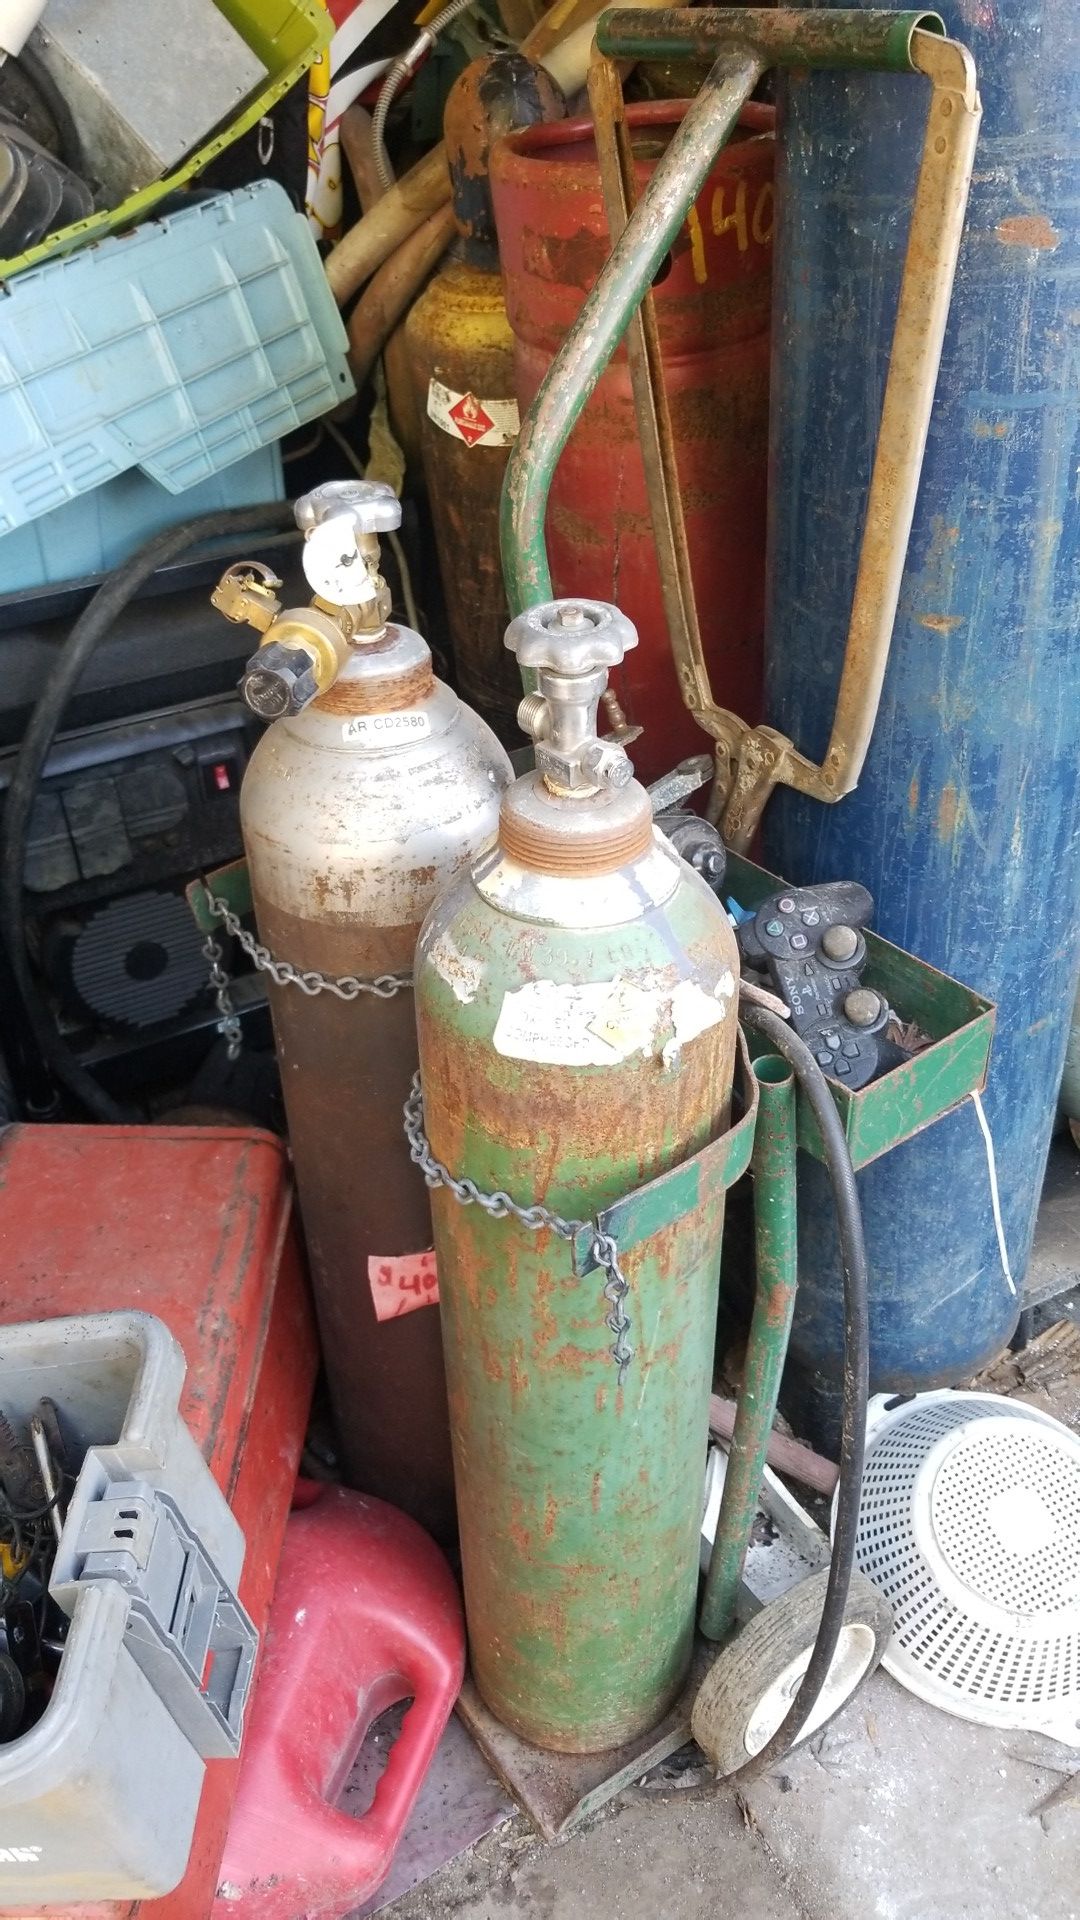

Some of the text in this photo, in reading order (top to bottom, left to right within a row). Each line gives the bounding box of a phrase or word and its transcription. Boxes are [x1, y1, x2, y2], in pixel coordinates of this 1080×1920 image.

[348, 716, 425, 736] AR CD2580
[784, 976, 804, 1015] SONY
